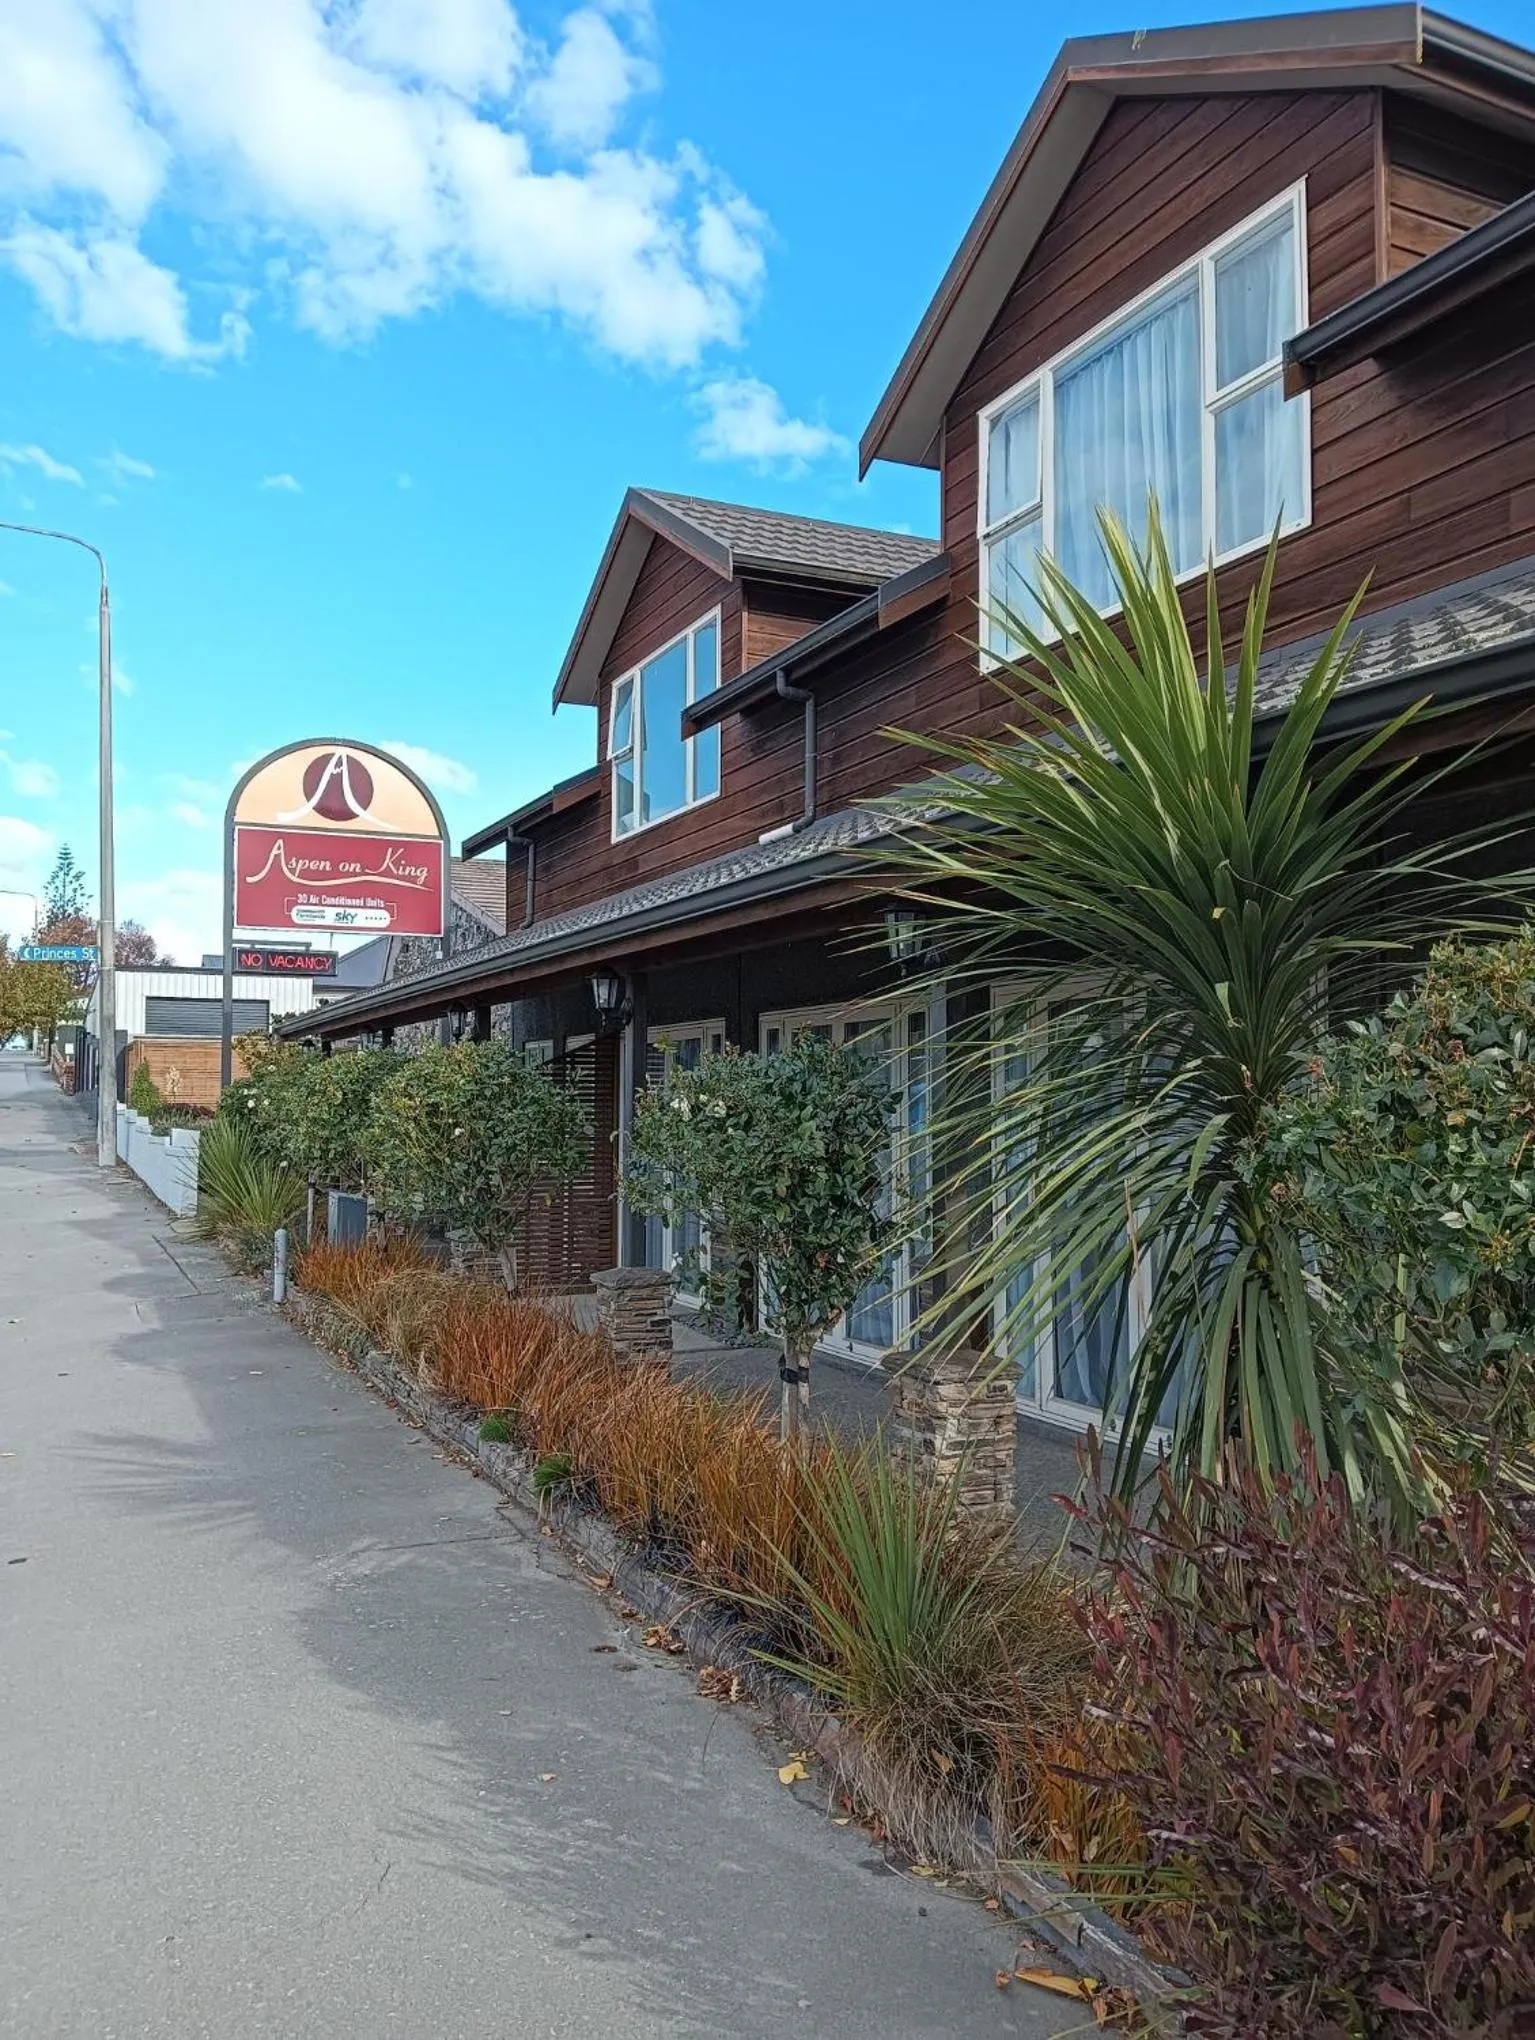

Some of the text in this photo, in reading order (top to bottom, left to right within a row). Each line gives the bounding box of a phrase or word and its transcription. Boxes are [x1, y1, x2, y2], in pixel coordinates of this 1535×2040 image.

[246, 838, 428, 886] Aspen on King
[309, 894, 319, 904] Air
[321, 895, 364, 906] Conditioned
[365, 897, 385, 908] Units
[33, 947, 95, 960] Princes St
[241, 952, 333, 971] NO VACANCY
